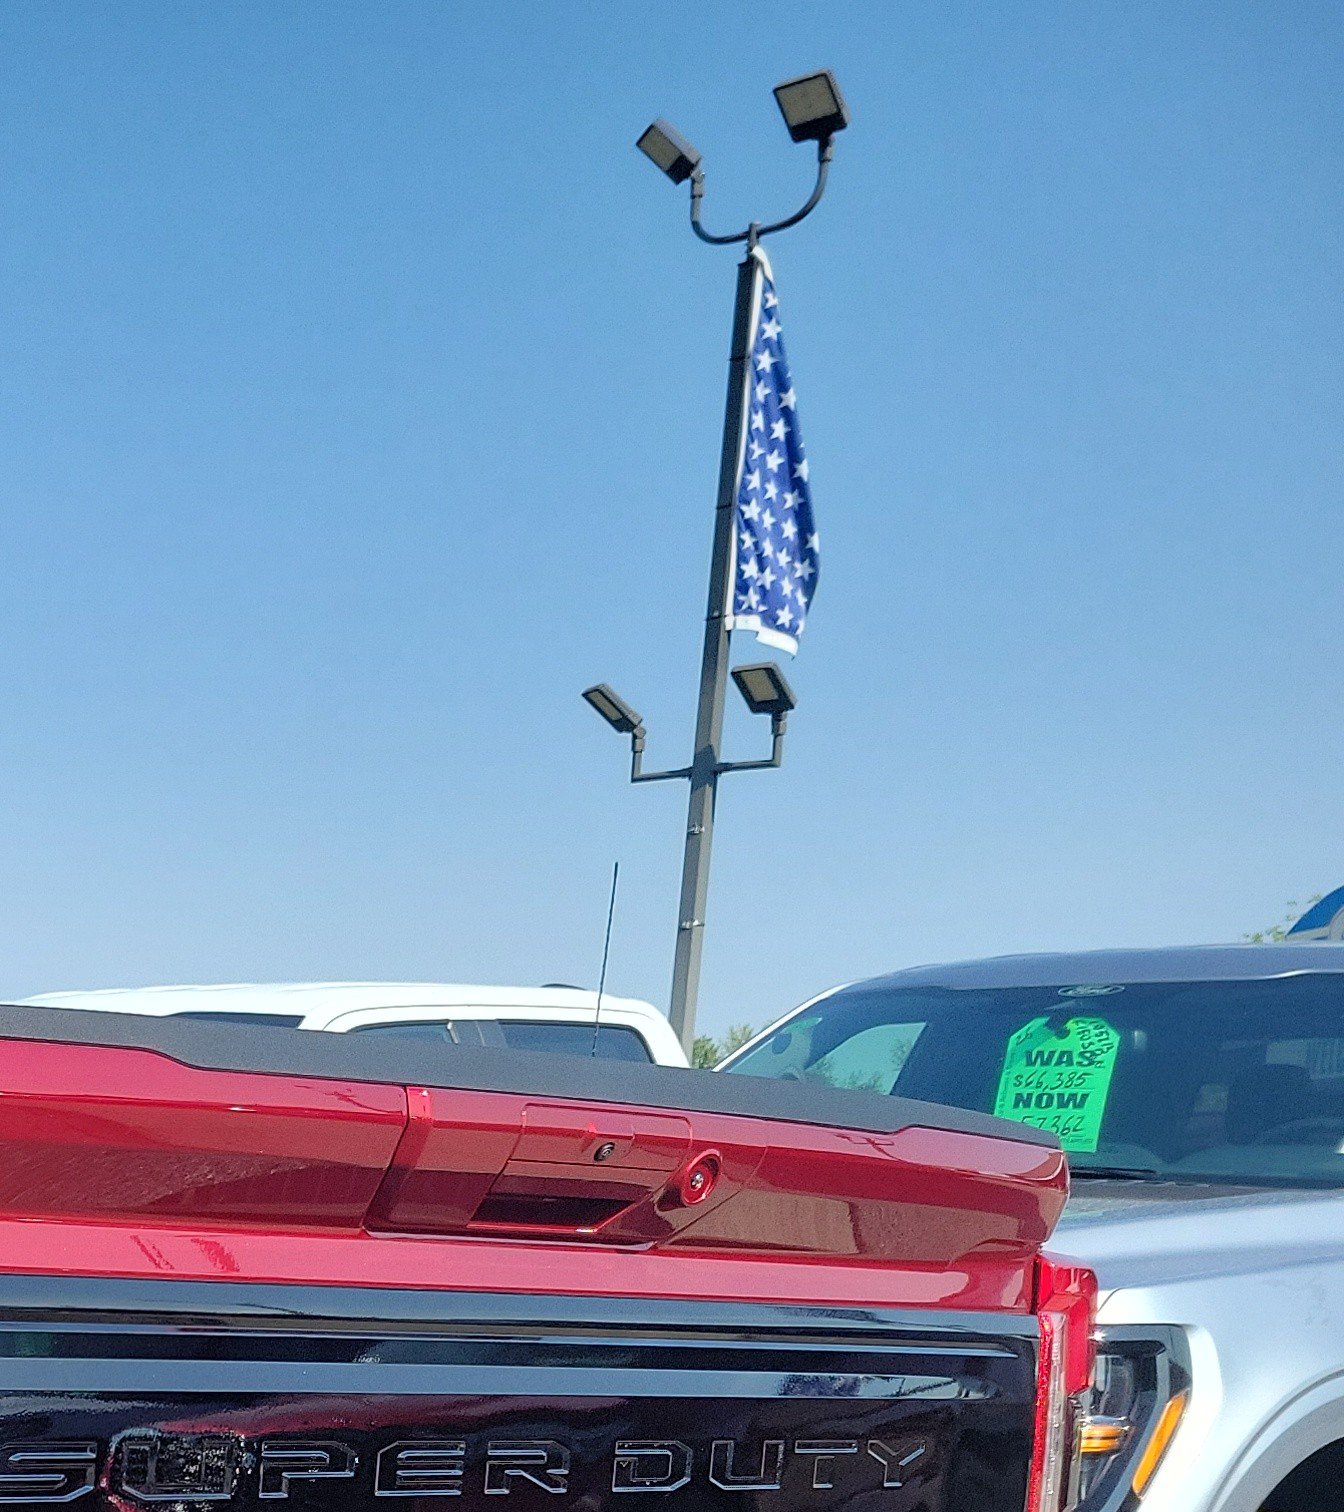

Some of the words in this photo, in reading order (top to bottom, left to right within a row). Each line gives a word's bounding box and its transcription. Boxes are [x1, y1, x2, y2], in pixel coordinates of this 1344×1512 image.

[1025, 1050, 1096, 1068] WAS
[1013, 1092, 1090, 1110] NOW
[612, 1439, 926, 1493] DUTY
